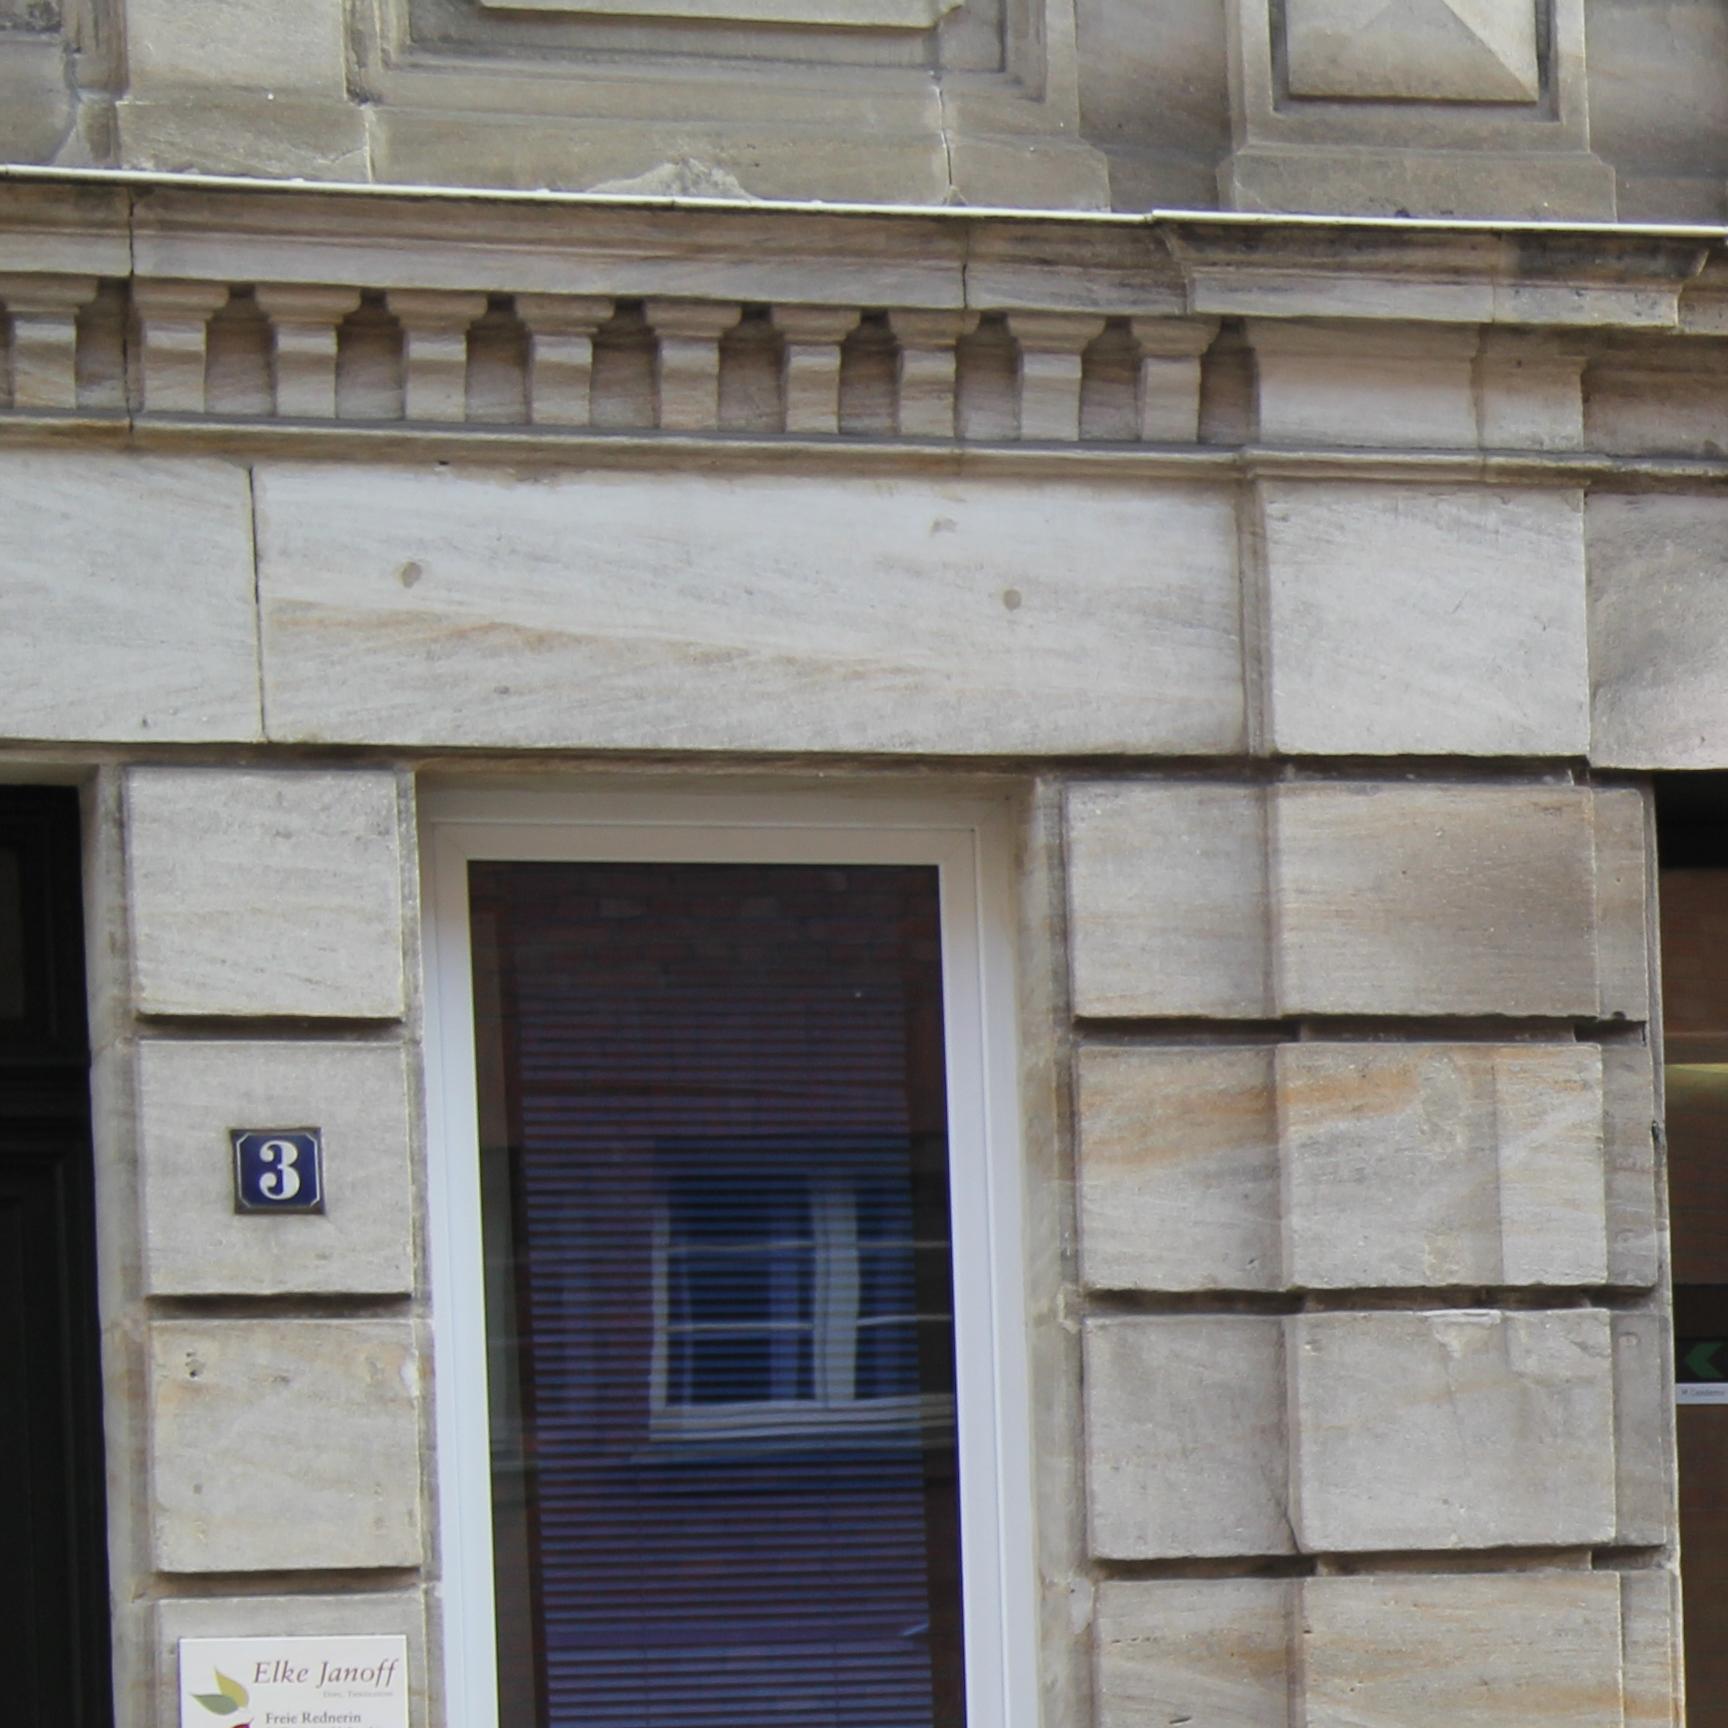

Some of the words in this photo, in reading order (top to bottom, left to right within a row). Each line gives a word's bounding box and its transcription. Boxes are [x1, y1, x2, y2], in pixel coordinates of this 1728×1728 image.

[258, 1139, 301, 1201] 3
[253, 1659, 310, 1685] Elke
[314, 1658, 400, 1689] Janoff
[265, 1711, 298, 1725] Freie
[302, 1711, 362, 1725] Rednerin
